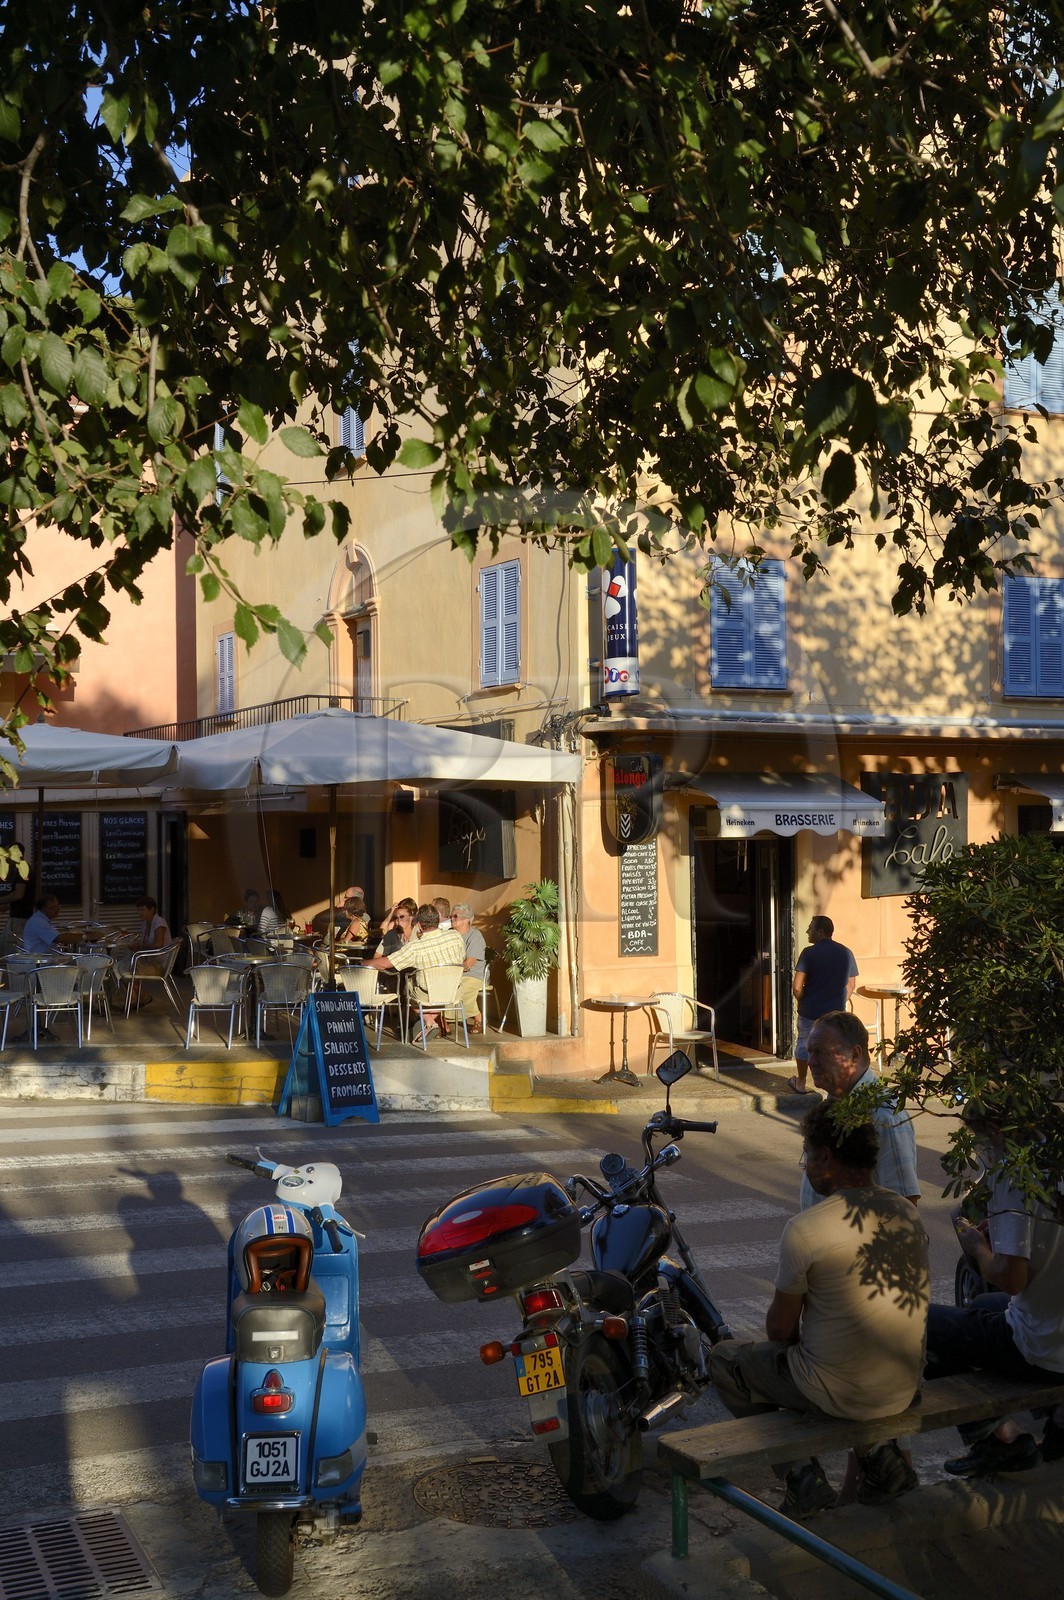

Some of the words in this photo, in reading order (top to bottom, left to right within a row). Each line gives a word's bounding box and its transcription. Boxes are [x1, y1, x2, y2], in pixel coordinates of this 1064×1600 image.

[103, 817, 118, 825] NOS
[118, 817, 145, 825] GLACES
[726, 818, 755, 826] Heineken
[775, 814, 836, 826] BRASSERIE
[852, 818, 880, 826] Hineken
[627, 930, 646, 939] BDA
[324, 1041, 359, 1055] SALADES
[328, 1062, 366, 1076] DESSERTS
[331, 1084, 372, 1098] FROMAGES
[530, 1350, 554, 1371] 795
[526, 1374, 540, 1394] GT
[545, 1370, 561, 1388] 2A
[255, 1441, 287, 1459] 1051
